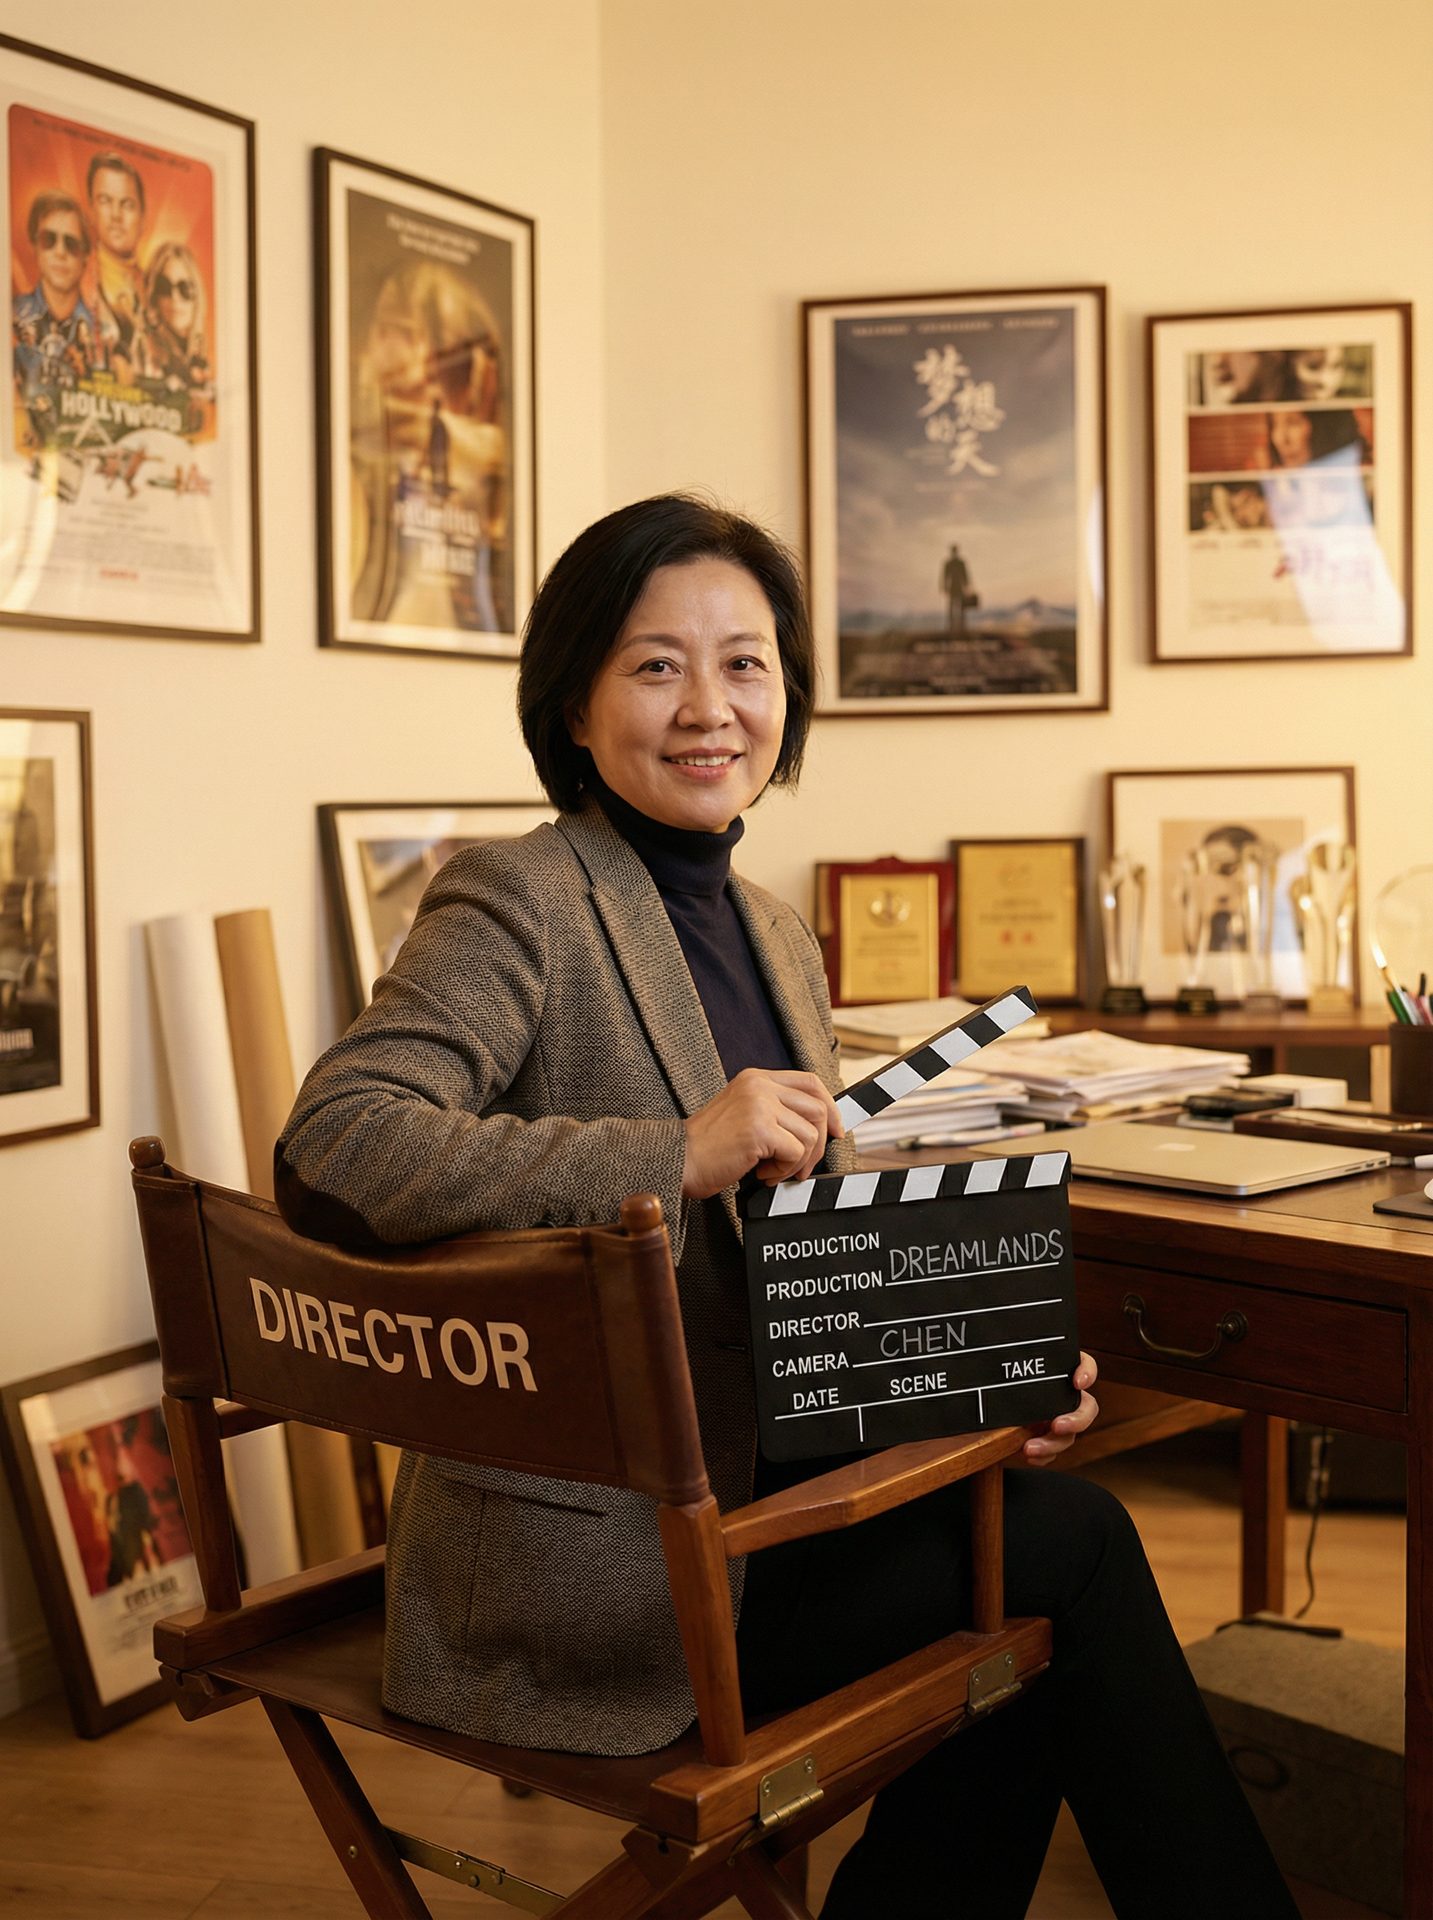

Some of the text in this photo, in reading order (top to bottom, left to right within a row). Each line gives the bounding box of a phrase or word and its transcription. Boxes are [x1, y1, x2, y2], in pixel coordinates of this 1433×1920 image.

[61, 390, 182, 432] HOLLYWOOD
[763, 1232, 880, 1262] PRODUCTION
[889, 1229, 1064, 1281] DREAMLANDS
[766, 1271, 883, 1301] PRODUCTION
[250, 1277, 538, 1392] DIRECTOR
[769, 1312, 860, 1340] DIRECTOR
[880, 1321, 966, 1357] CHEN
[772, 1352, 849, 1378] CAMERA
[793, 1358, 1046, 1410] DATE SCENE TAKE
